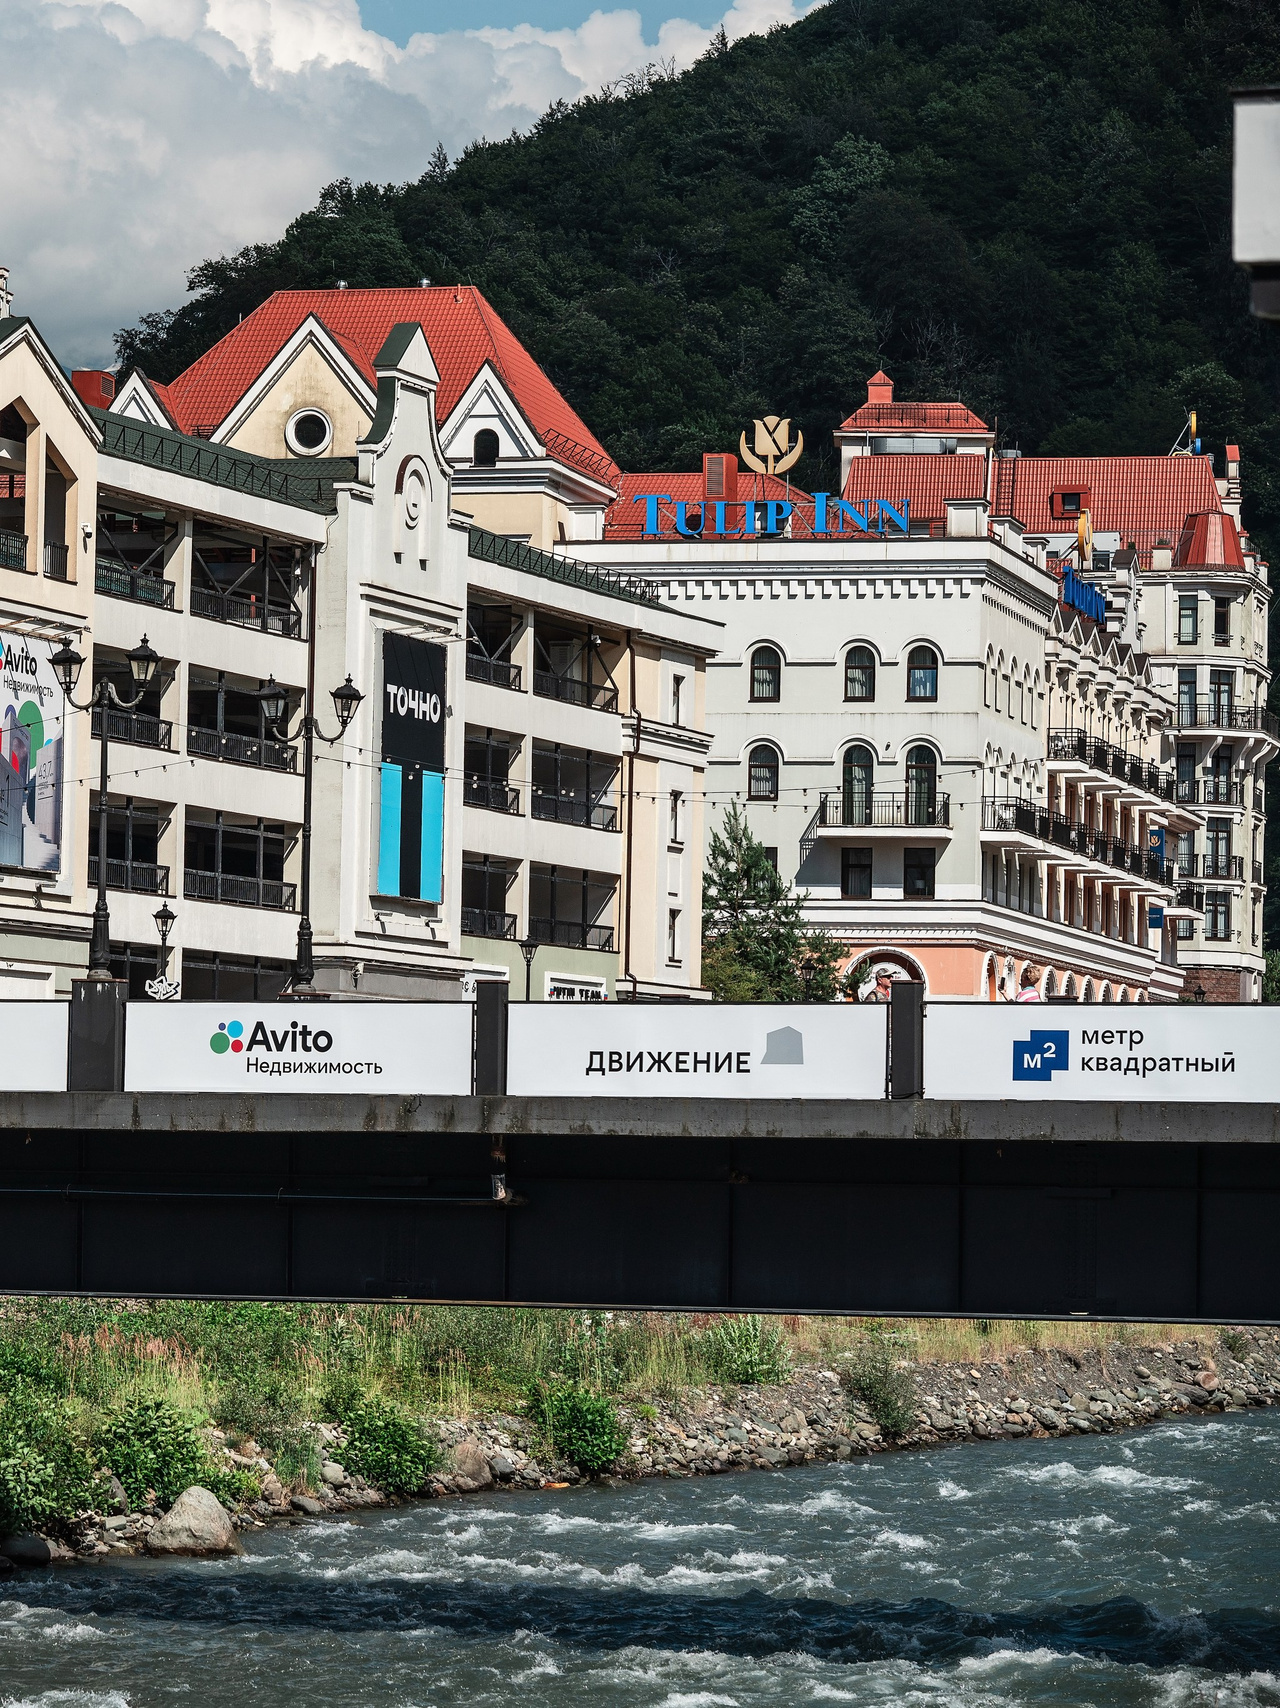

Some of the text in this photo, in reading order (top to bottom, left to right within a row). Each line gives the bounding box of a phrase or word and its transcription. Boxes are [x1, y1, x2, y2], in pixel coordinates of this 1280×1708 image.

[633, 492, 911, 535] TULIP INN
[3, 644, 38, 676] Avito
[3, 675, 54, 698] Недвижимость
[386, 683, 441, 724] ТОЧНО
[245, 1020, 334, 1053] Avito
[1081, 1029, 1144, 1051] метр
[246, 1057, 383, 1076] Недвижимость
[585, 1050, 751, 1076] ДВИЖЕНИЕ
[1081, 1052, 1235, 1078] квадратный
